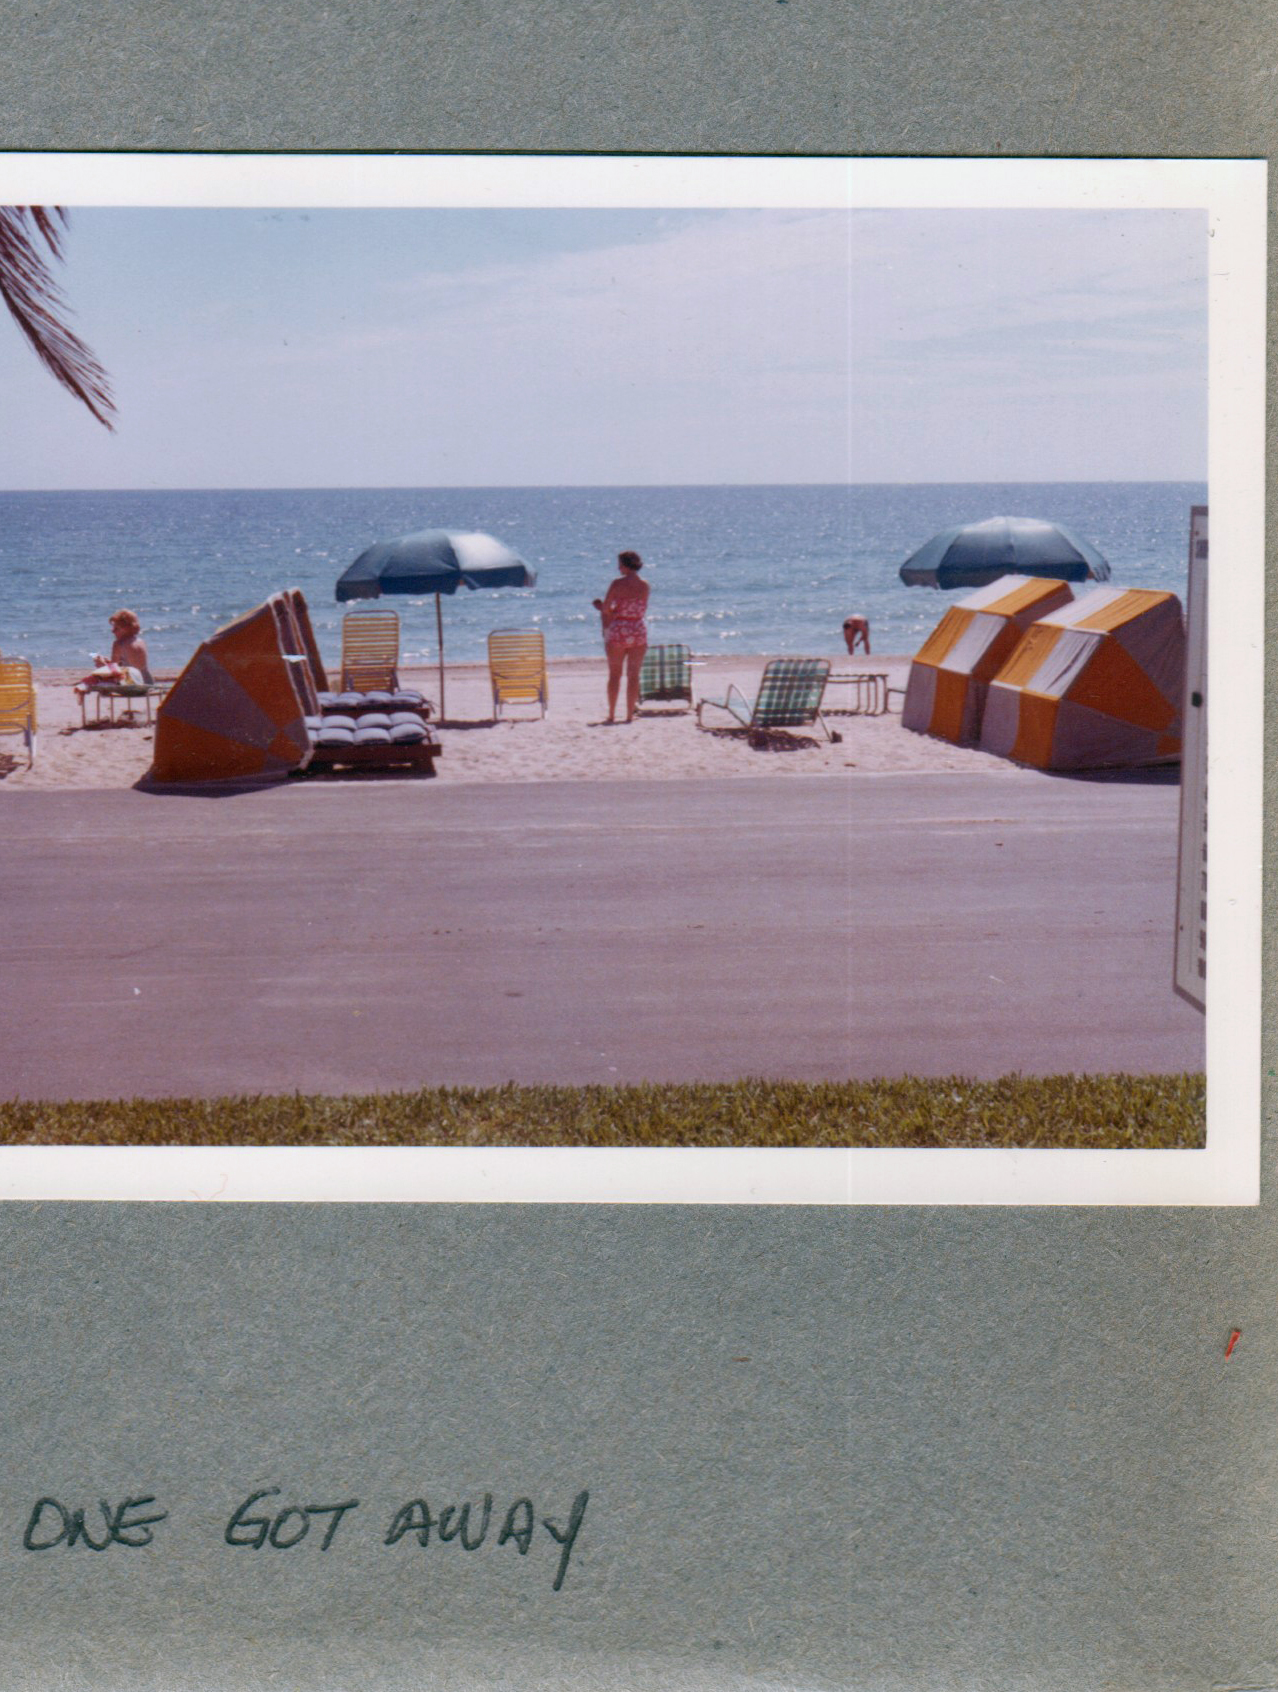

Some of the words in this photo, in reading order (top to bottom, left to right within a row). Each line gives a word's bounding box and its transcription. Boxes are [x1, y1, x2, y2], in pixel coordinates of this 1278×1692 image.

[24, 1494, 167, 1552] ONE
[225, 1488, 360, 1552] GOT
[385, 1489, 590, 1592] AWAY
